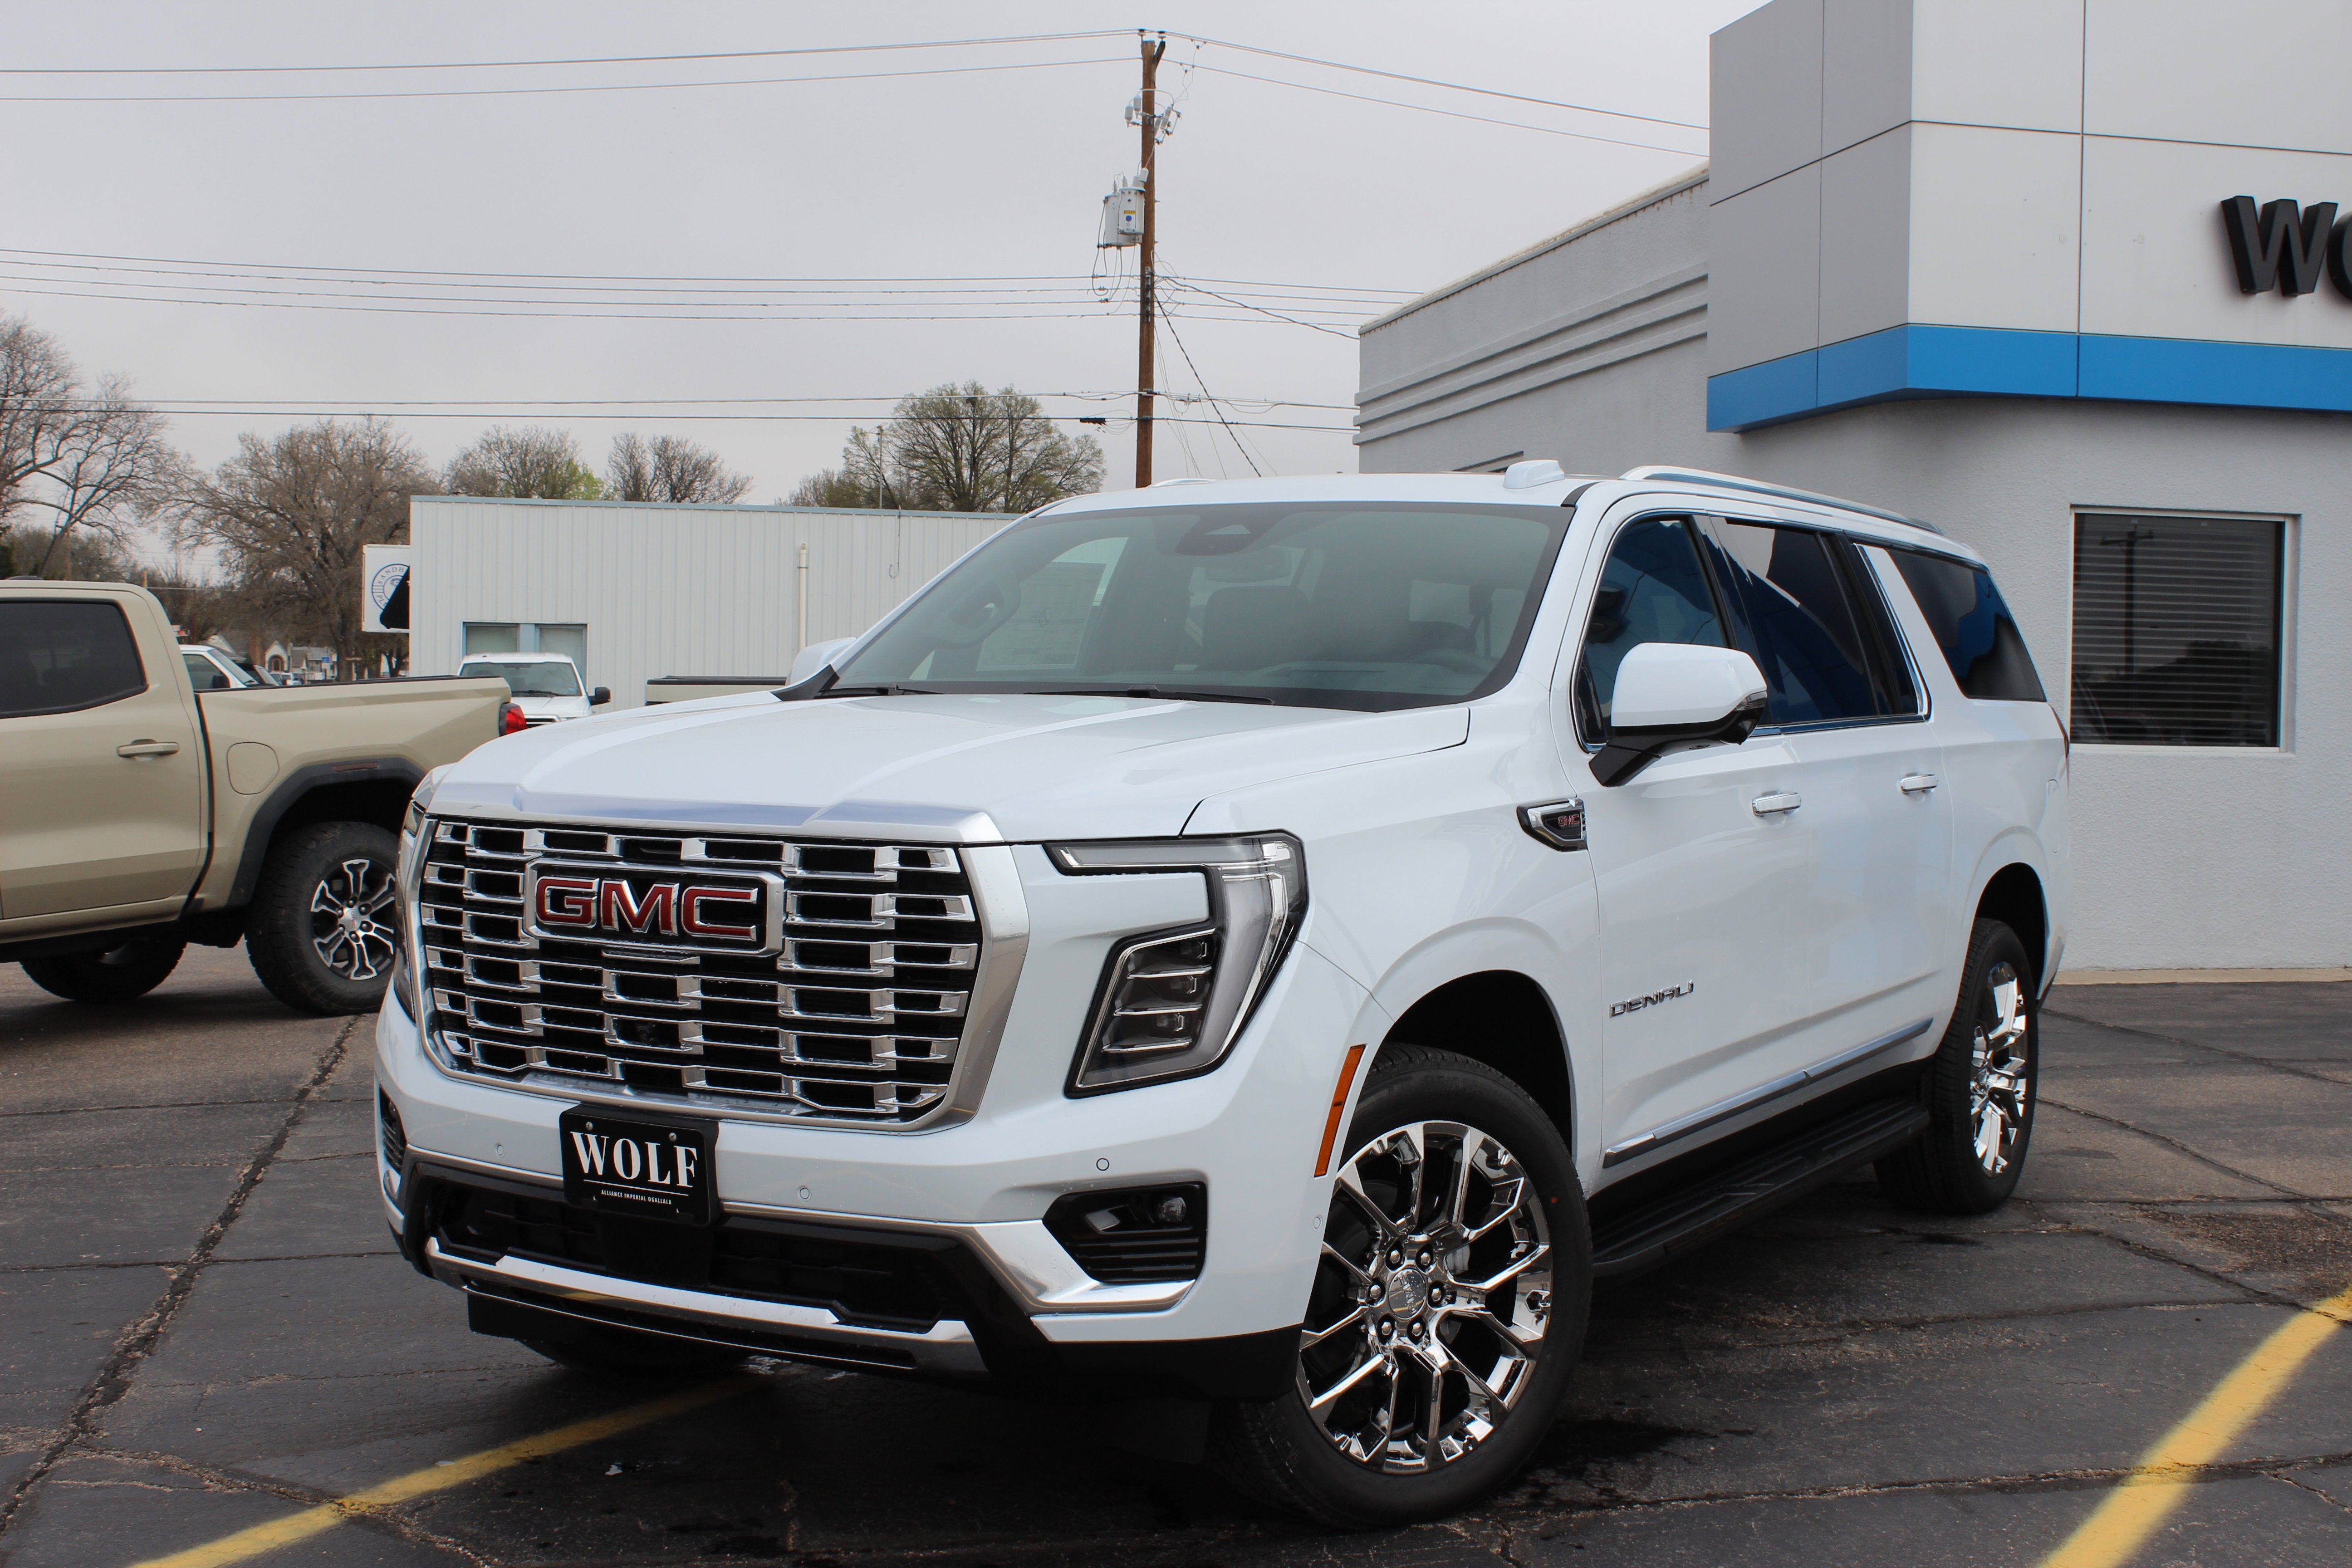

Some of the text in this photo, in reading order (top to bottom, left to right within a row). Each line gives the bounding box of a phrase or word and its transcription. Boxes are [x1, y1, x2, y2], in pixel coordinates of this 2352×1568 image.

[1558, 814, 1579, 826] GMC
[535, 876, 758, 942] GMC
[1609, 979, 1694, 1018] DENALI
[570, 1131, 698, 1188] WOLF
[601, 1189, 672, 1205] ALLIANCE IMPERIAL OGALLALA
